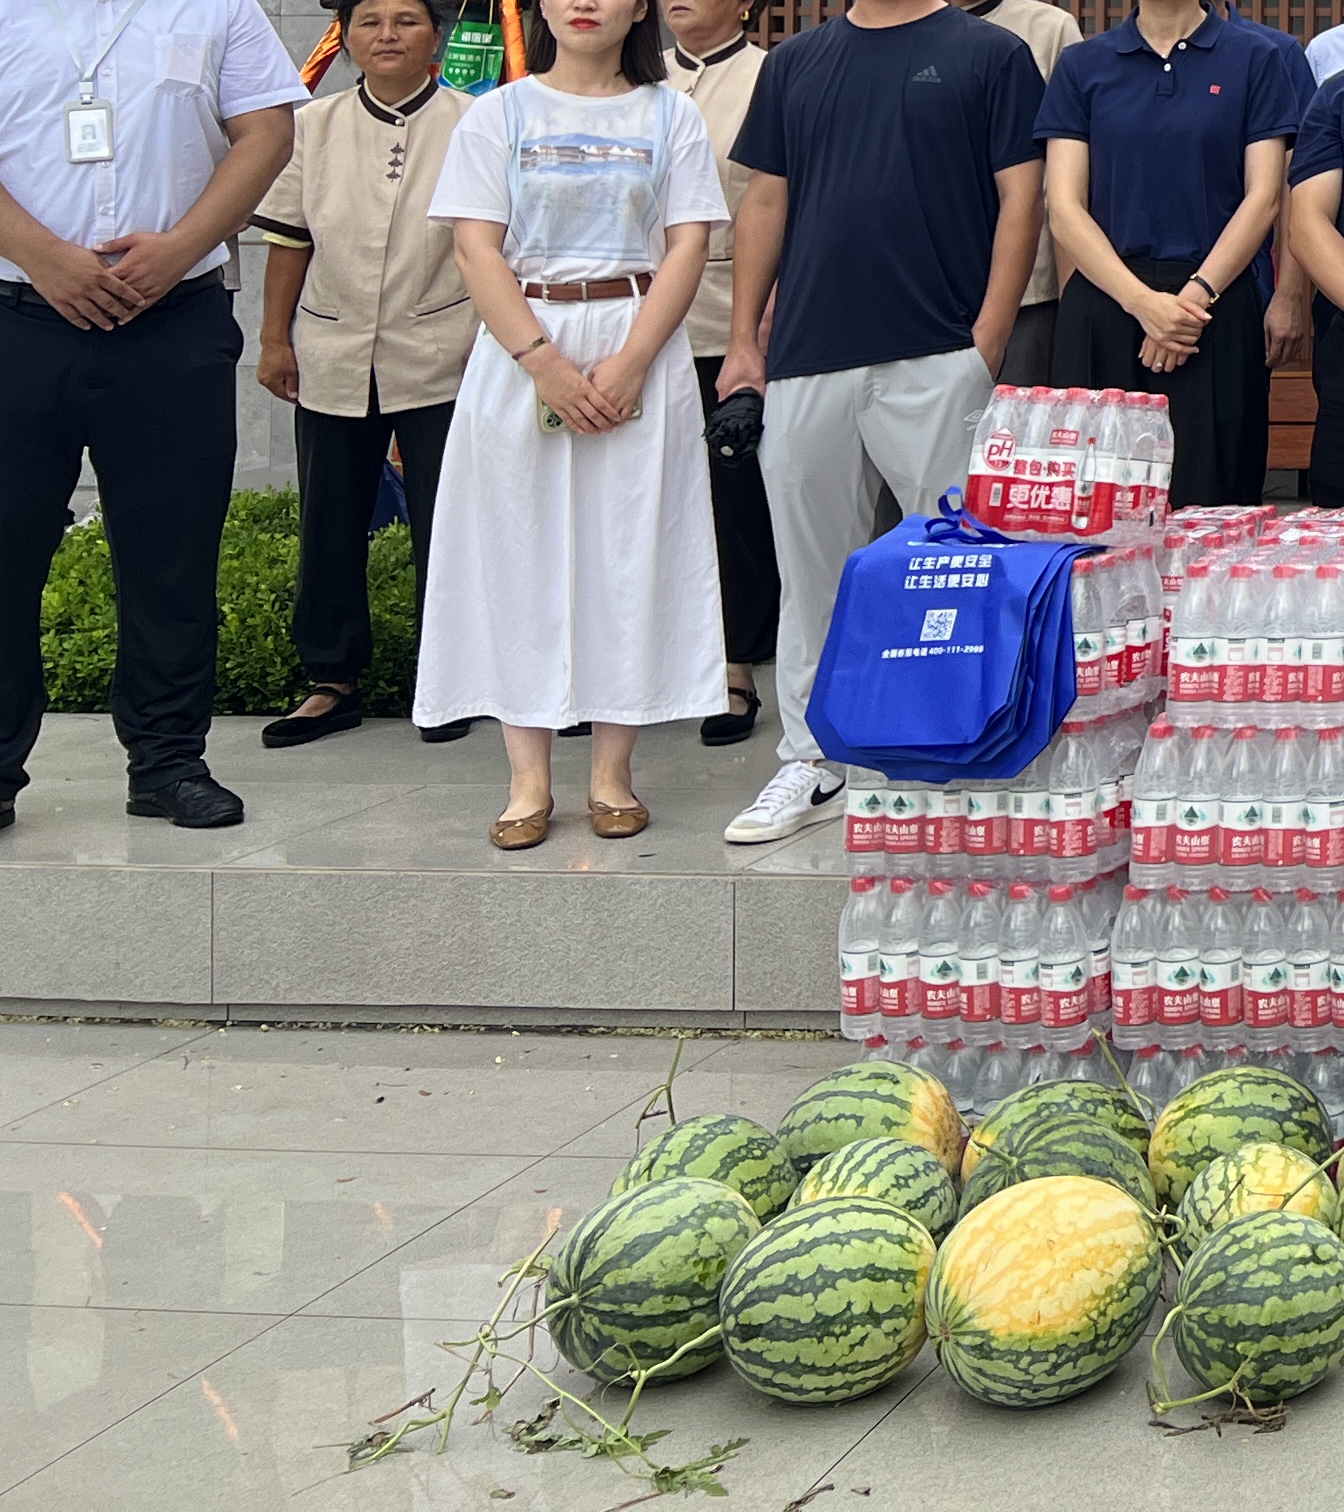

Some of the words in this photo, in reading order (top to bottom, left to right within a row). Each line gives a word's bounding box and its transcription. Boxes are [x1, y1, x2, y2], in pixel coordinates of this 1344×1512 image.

[988, 442, 1014, 459] pH
[1007, 484, 1072, 510] 更优惠
